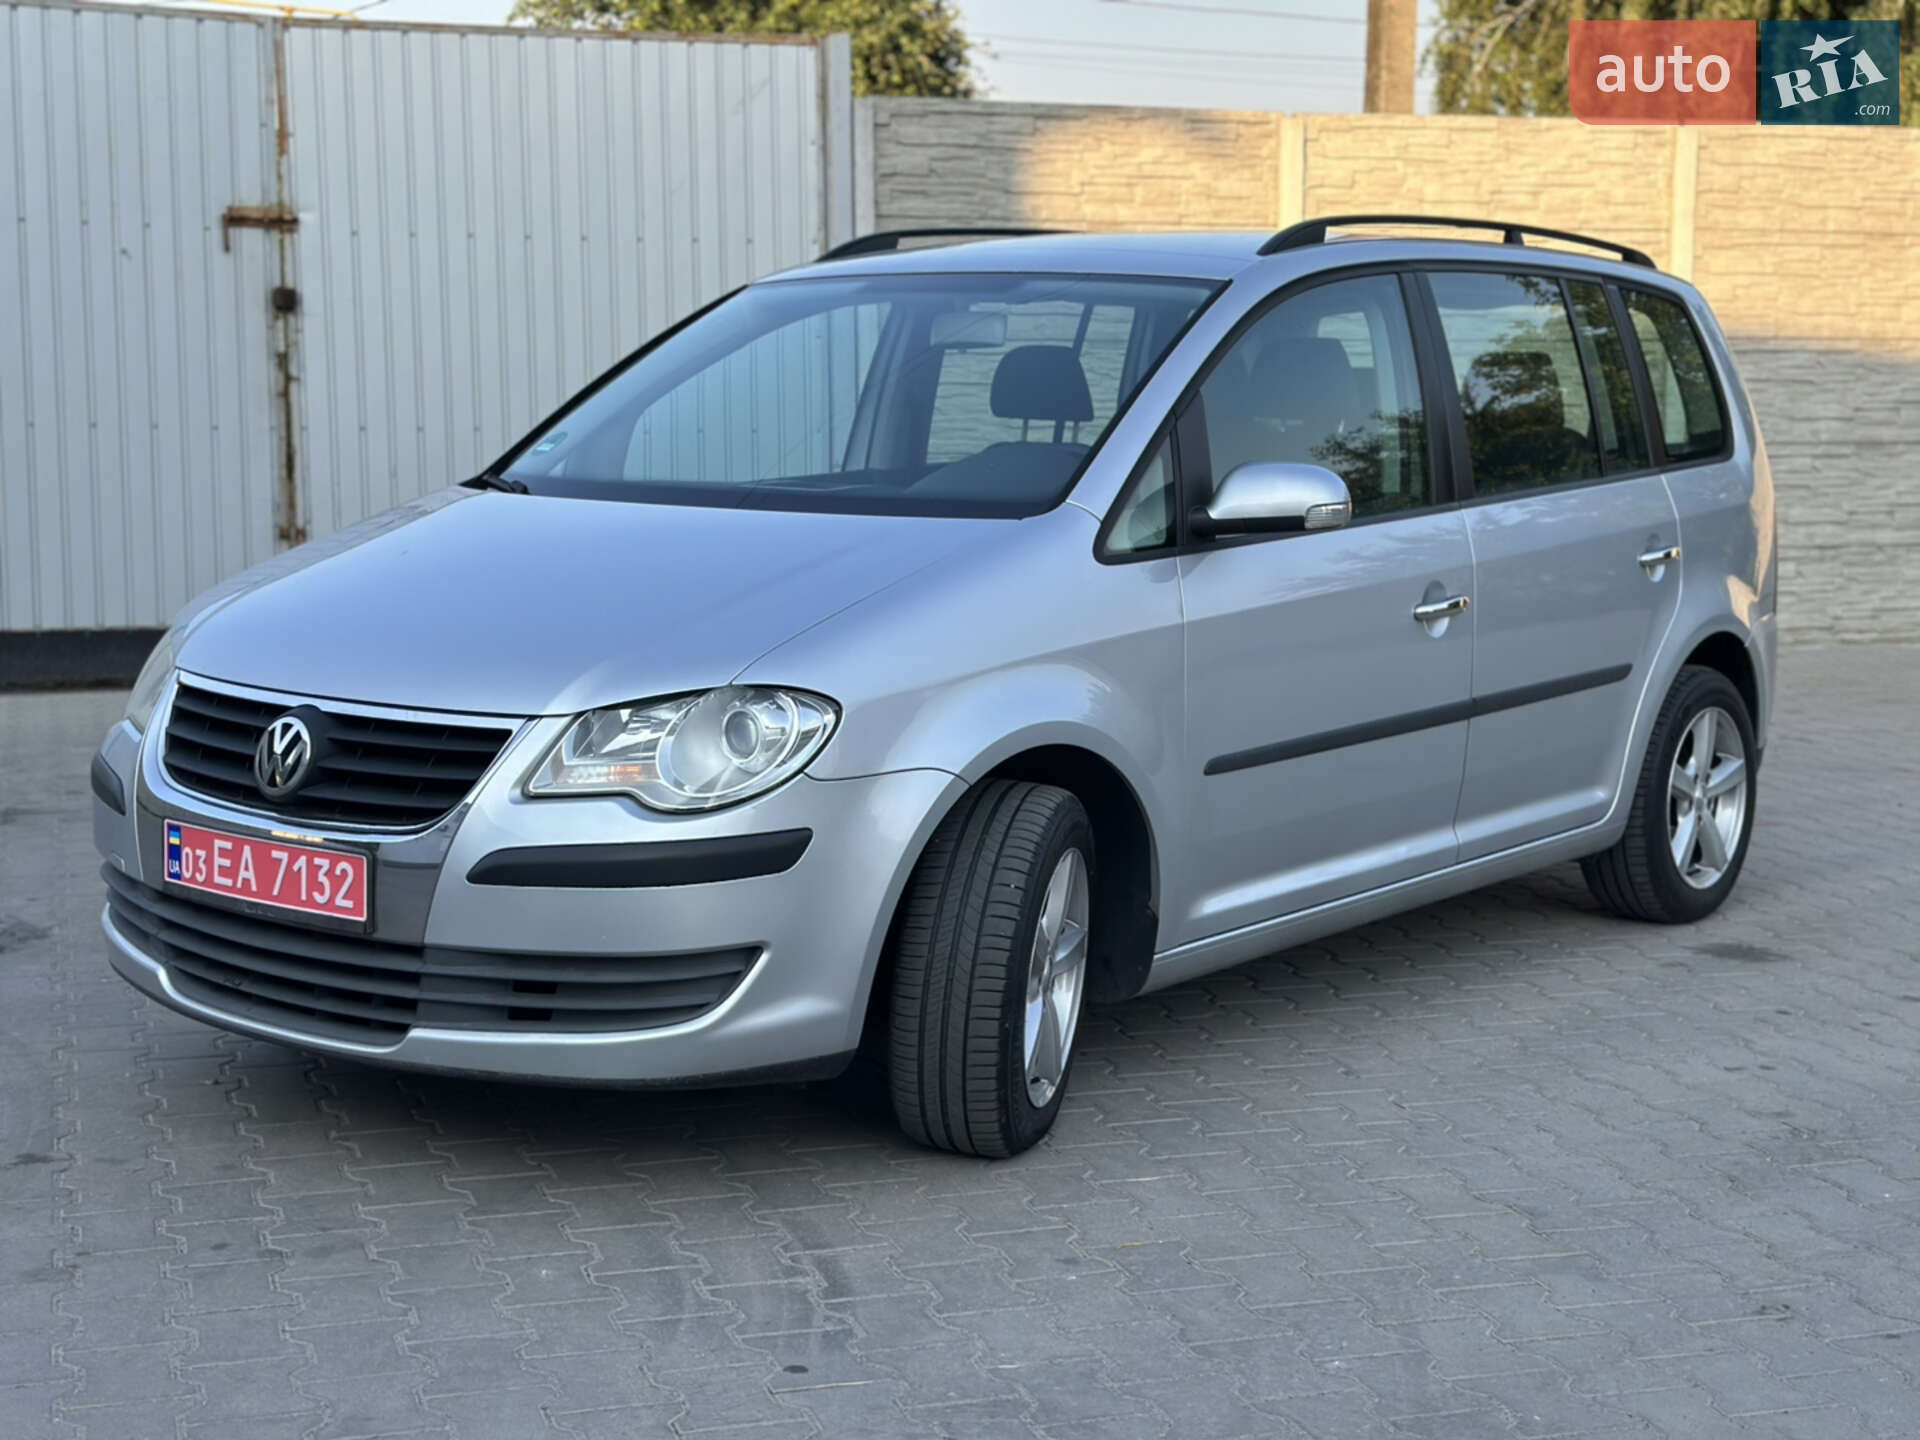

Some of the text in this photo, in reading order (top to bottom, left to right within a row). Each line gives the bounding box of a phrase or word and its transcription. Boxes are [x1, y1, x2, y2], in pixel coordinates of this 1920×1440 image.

[169, 859, 181, 874] UA
[182, 839, 354, 909] 03 EA 7132
